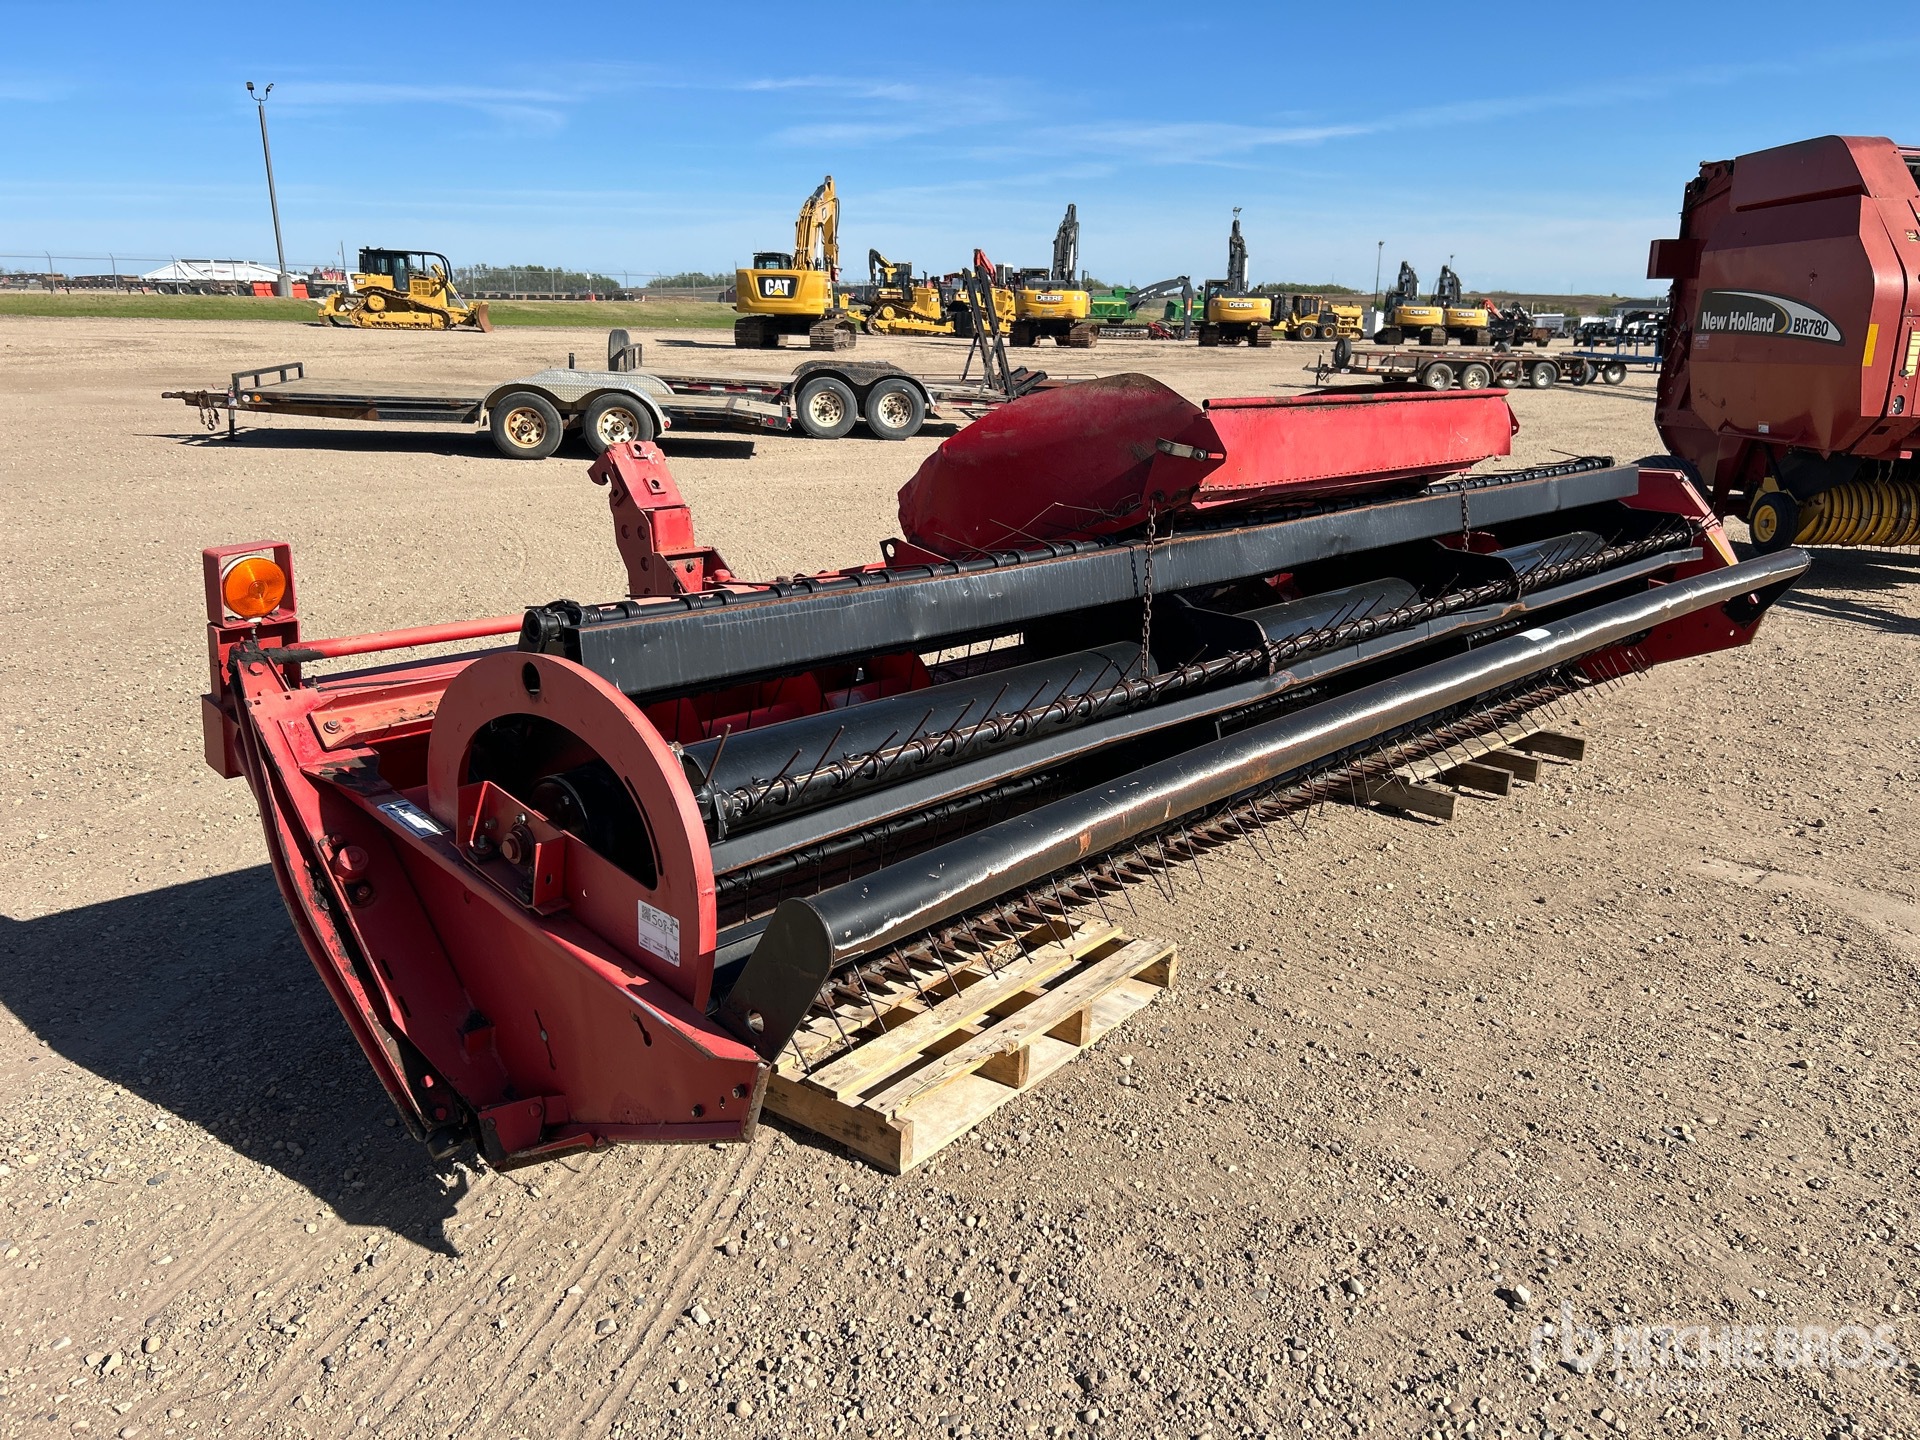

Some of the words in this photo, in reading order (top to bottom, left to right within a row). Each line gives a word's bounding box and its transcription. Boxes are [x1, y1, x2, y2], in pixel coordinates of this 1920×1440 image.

[765, 278, 791, 296] CAT
[1036, 294, 1063, 302] DEERE
[1701, 311, 1727, 330] New
[1728, 311, 1776, 333] Holland
[1793, 317, 1829, 337] BR780
